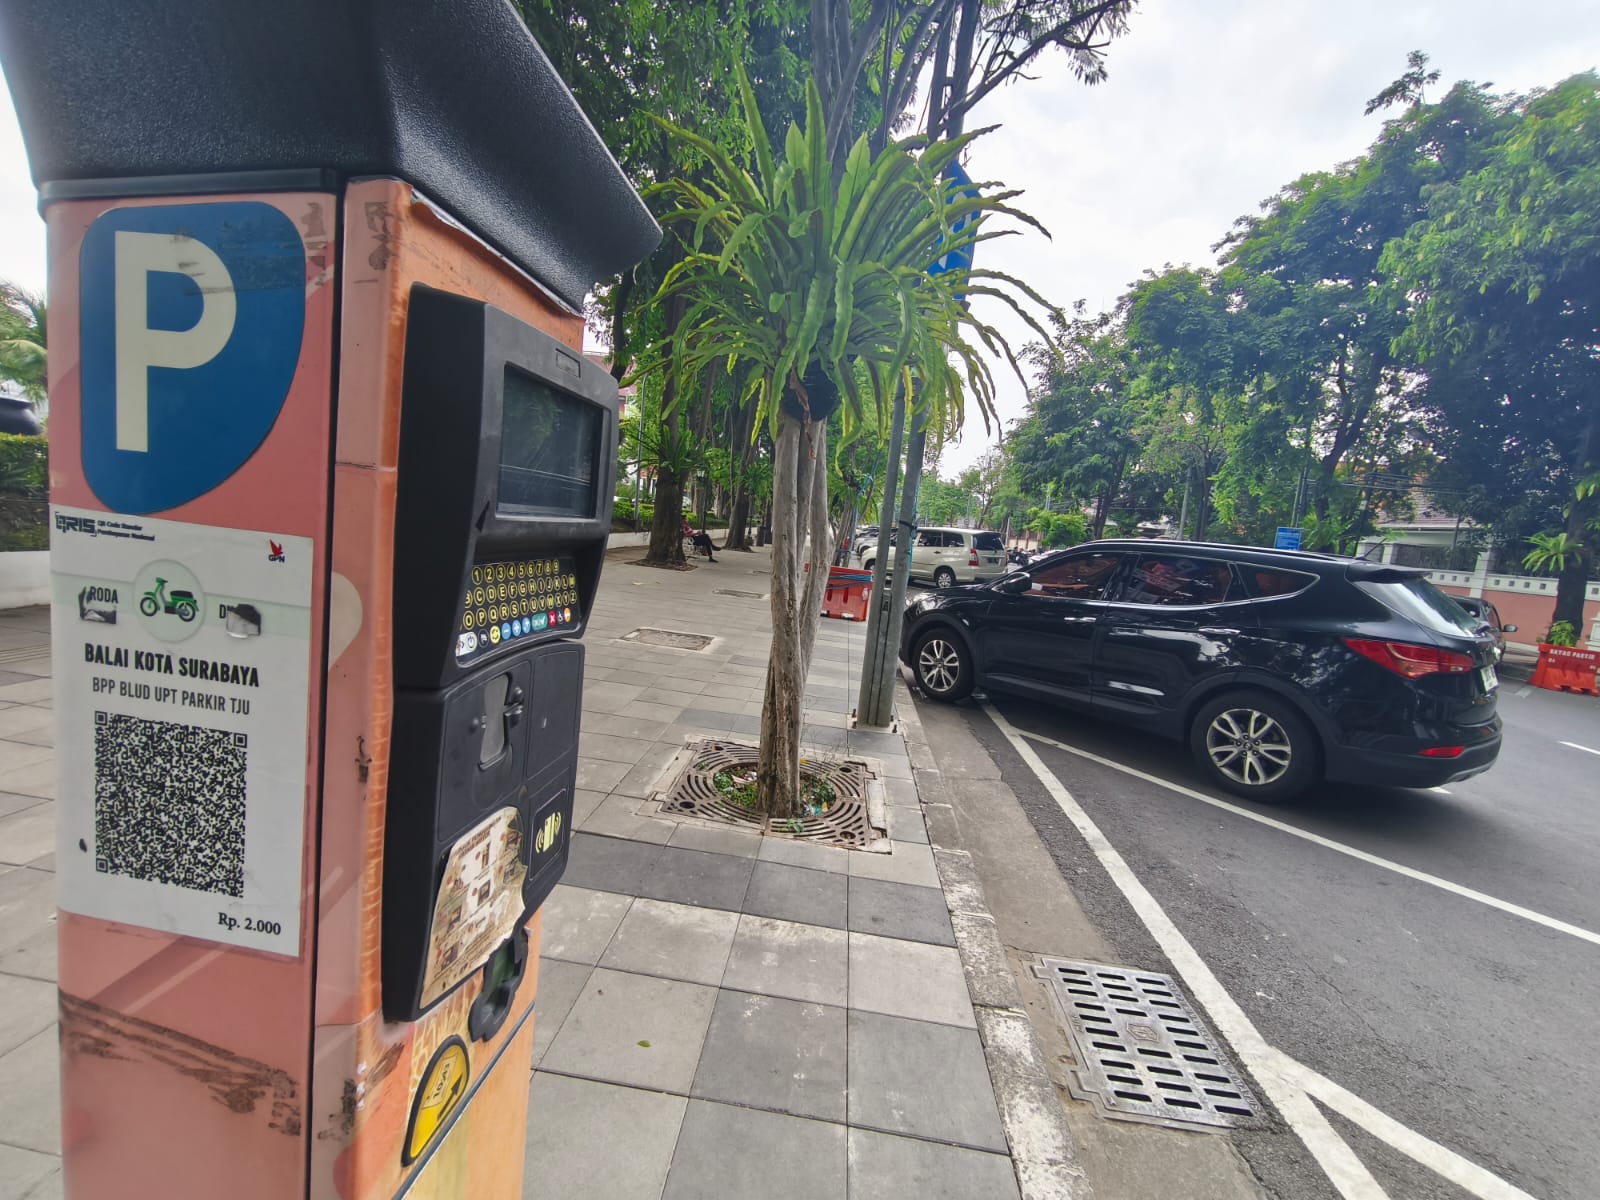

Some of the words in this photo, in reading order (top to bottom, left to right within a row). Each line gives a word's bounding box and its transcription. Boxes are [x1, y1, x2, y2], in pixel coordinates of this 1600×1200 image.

[115, 231, 237, 453] P
[55, 513, 96, 534] QRIS
[268, 554, 285, 563] GPN
[89, 586, 119, 604] RODA
[84, 642, 129, 668] BALAI
[134, 650, 173, 675] KOTA
[178, 657, 260, 688] SURABAYA
[92, 676, 116, 695] BPP
[119, 681, 151, 700] BLUD
[154, 686, 178, 705] UPT
[181, 690, 226, 712] PARKIR
[229, 697, 250, 715] TJU
[218, 912, 240, 931] Rp.
[244, 917, 282, 936] 2.000
